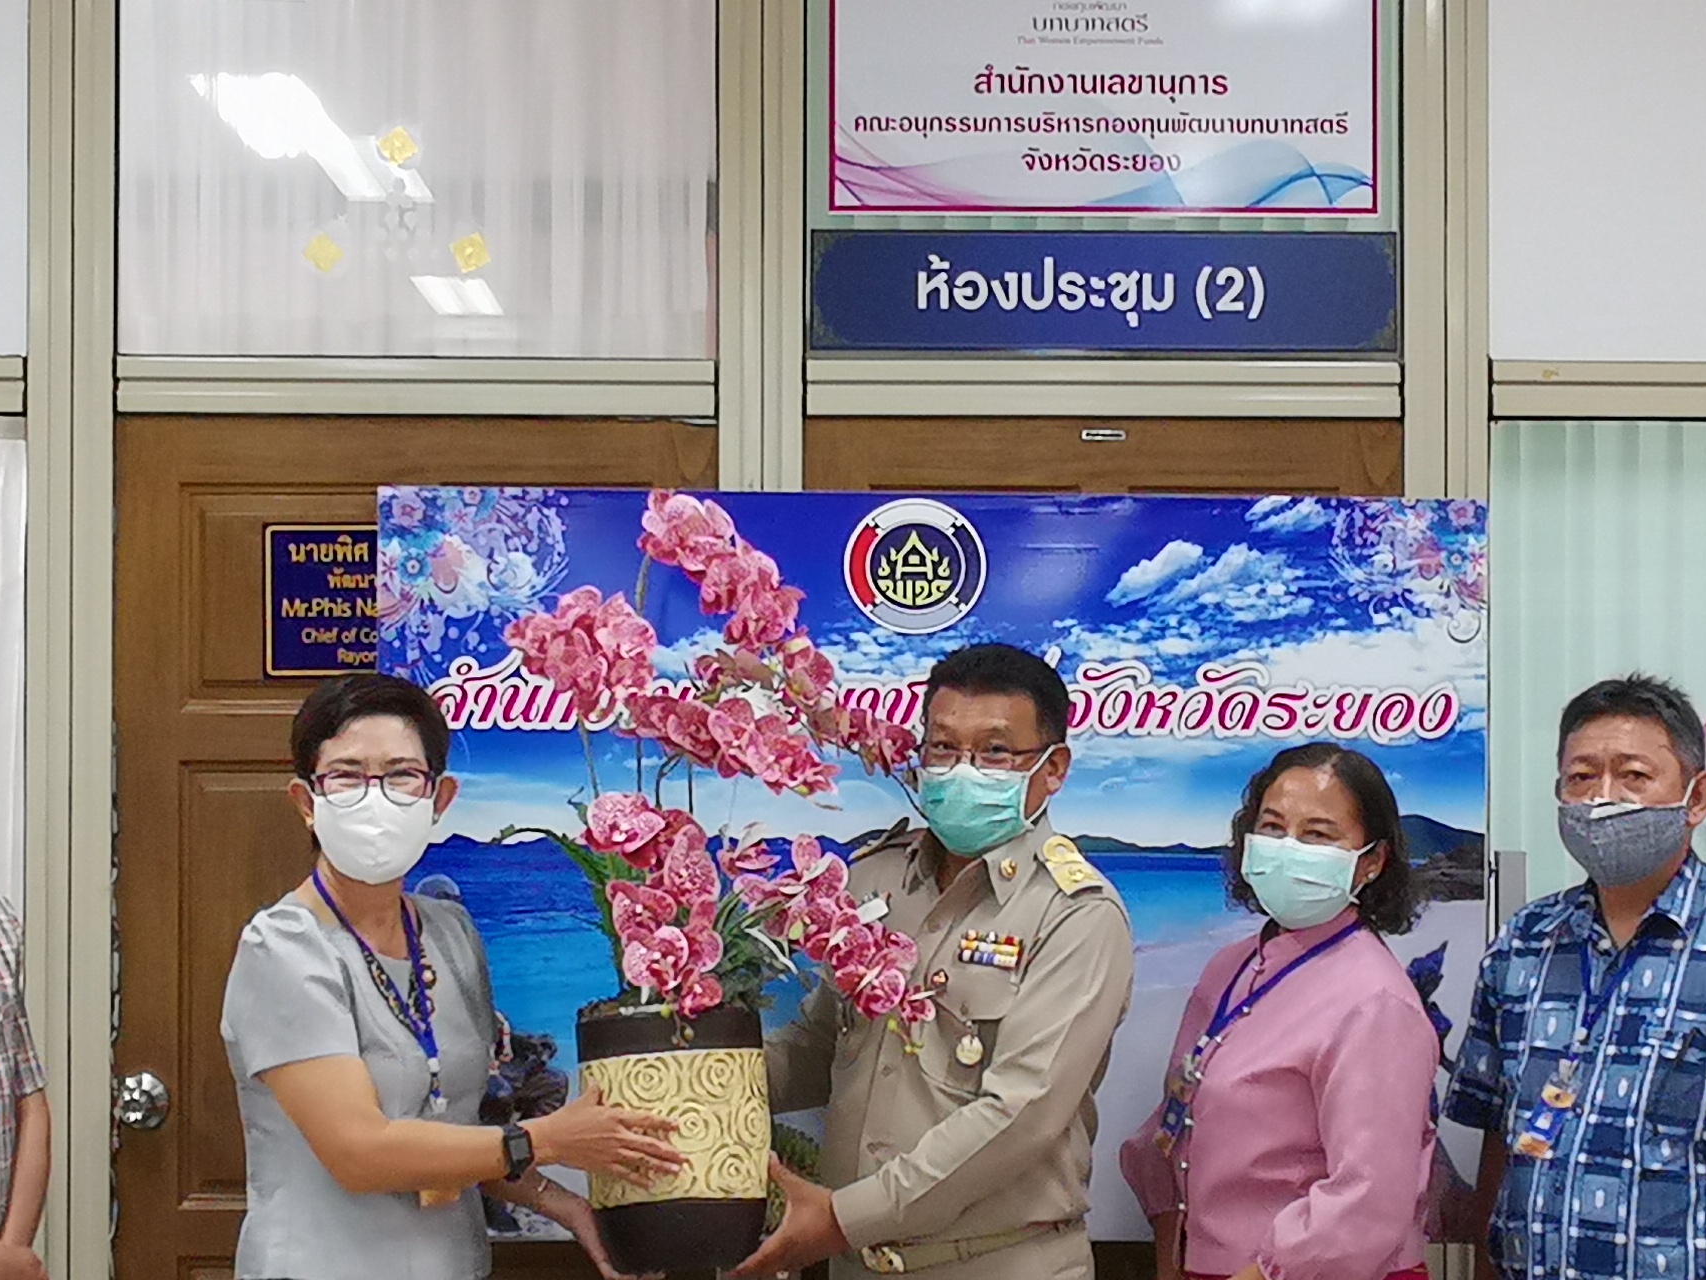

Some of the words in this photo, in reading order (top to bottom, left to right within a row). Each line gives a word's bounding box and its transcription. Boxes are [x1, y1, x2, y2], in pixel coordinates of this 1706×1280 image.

[1031, 13, 1149, 33] บทบาทสตรี
[974, 64, 1229, 103] สำนักงานเลขานุการ
[853, 111, 1350, 139] คณะอนุกรรมการบริหารกองทุนพัฒนาบทบาทสตรี
[1021, 146, 1182, 173] จังหวัดระยอง
[916, 255, 1175, 327] ห้องประชุม
[1195, 266, 1265, 320] (2)
[288, 534, 370, 563] นายพิศ
[281, 597, 352, 618] Mr.Phis
[301, 627, 338, 644] Chief
[341, 627, 358, 644] of
